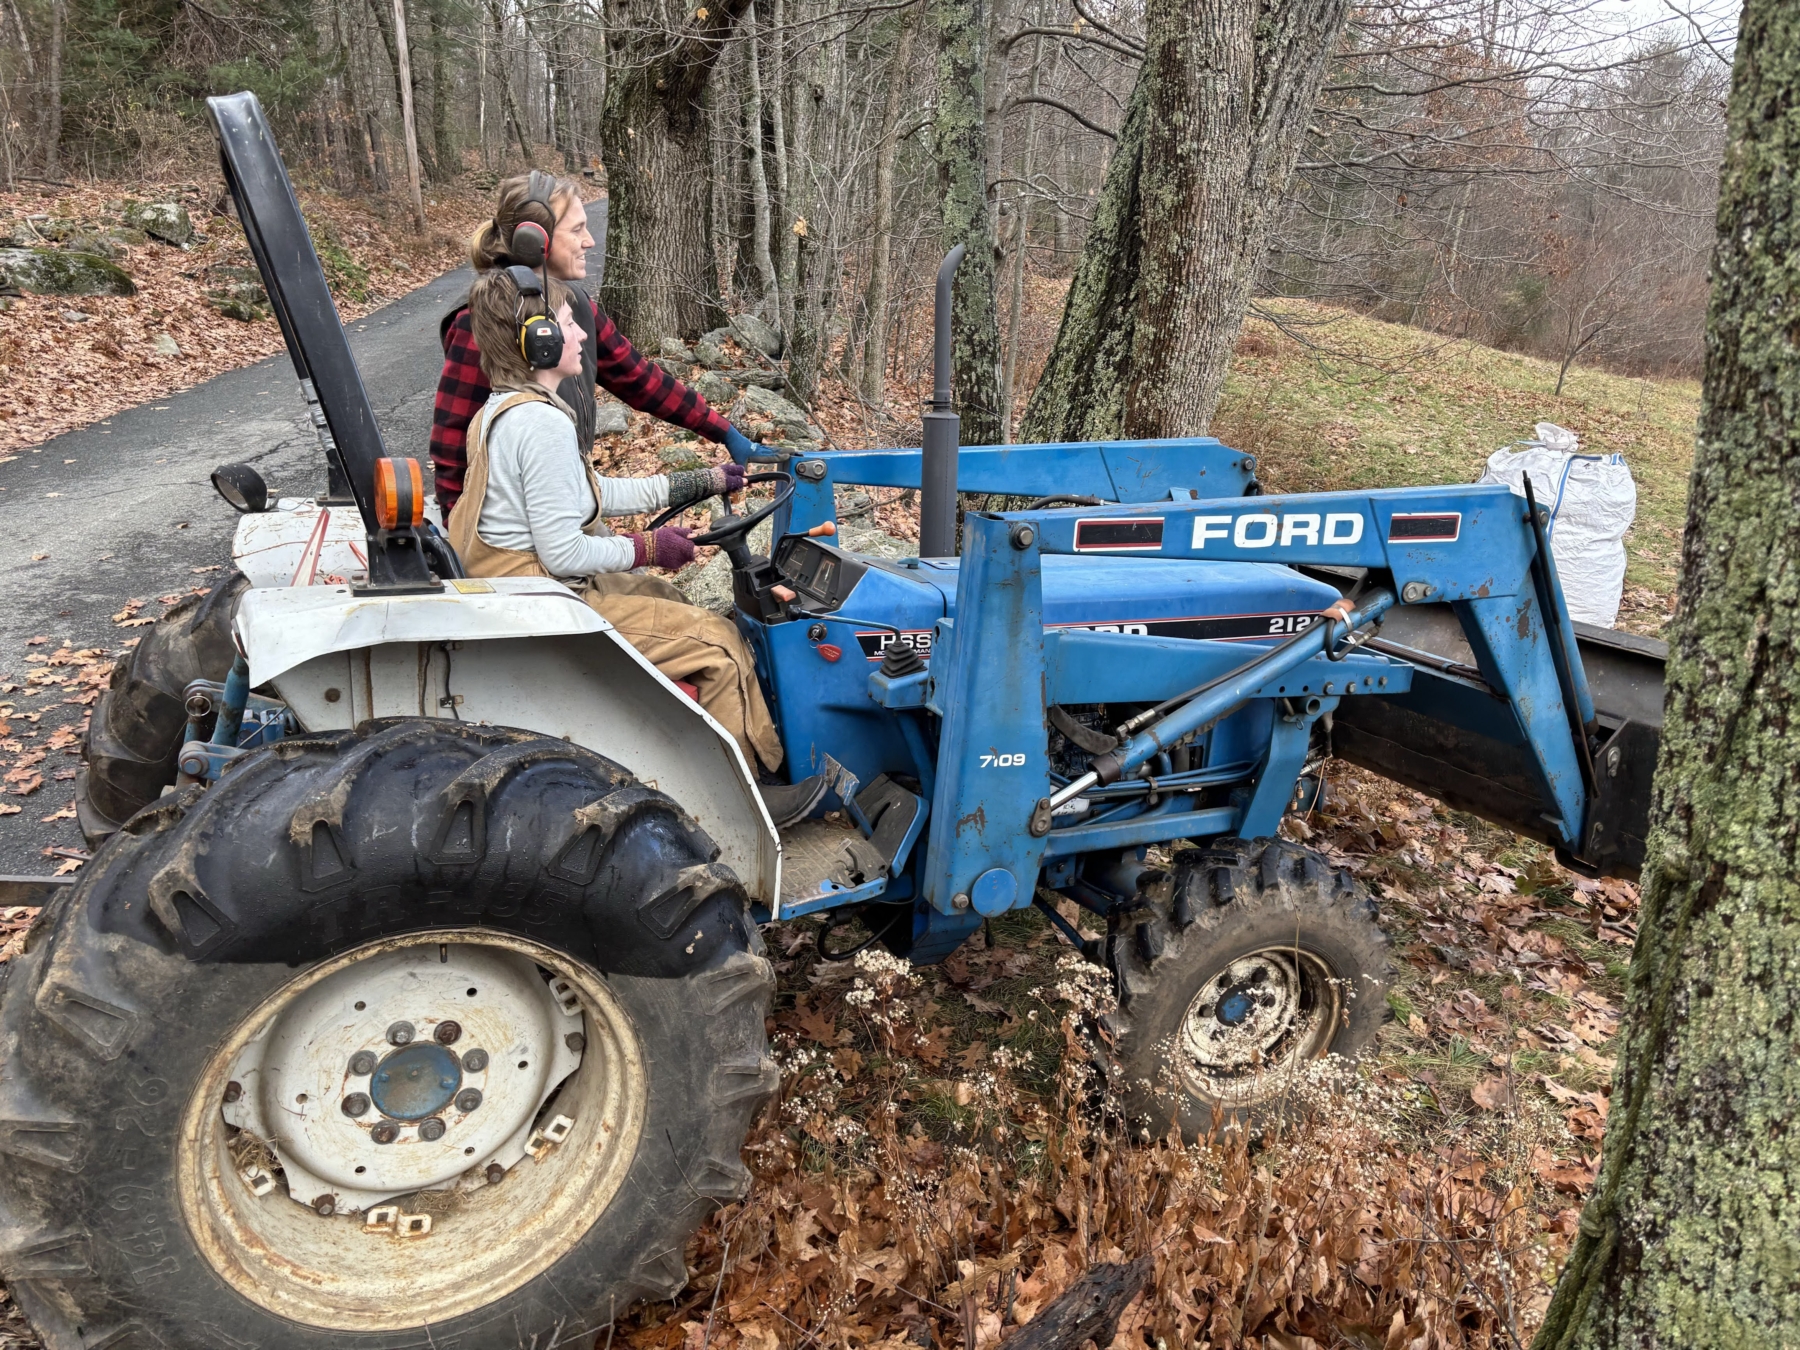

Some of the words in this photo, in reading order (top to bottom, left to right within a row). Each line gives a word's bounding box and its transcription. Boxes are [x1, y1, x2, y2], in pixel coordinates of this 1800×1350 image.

[1191, 512, 1364, 549] FORD
[1268, 615, 1320, 633] 212
[979, 753, 1026, 768] 7109
